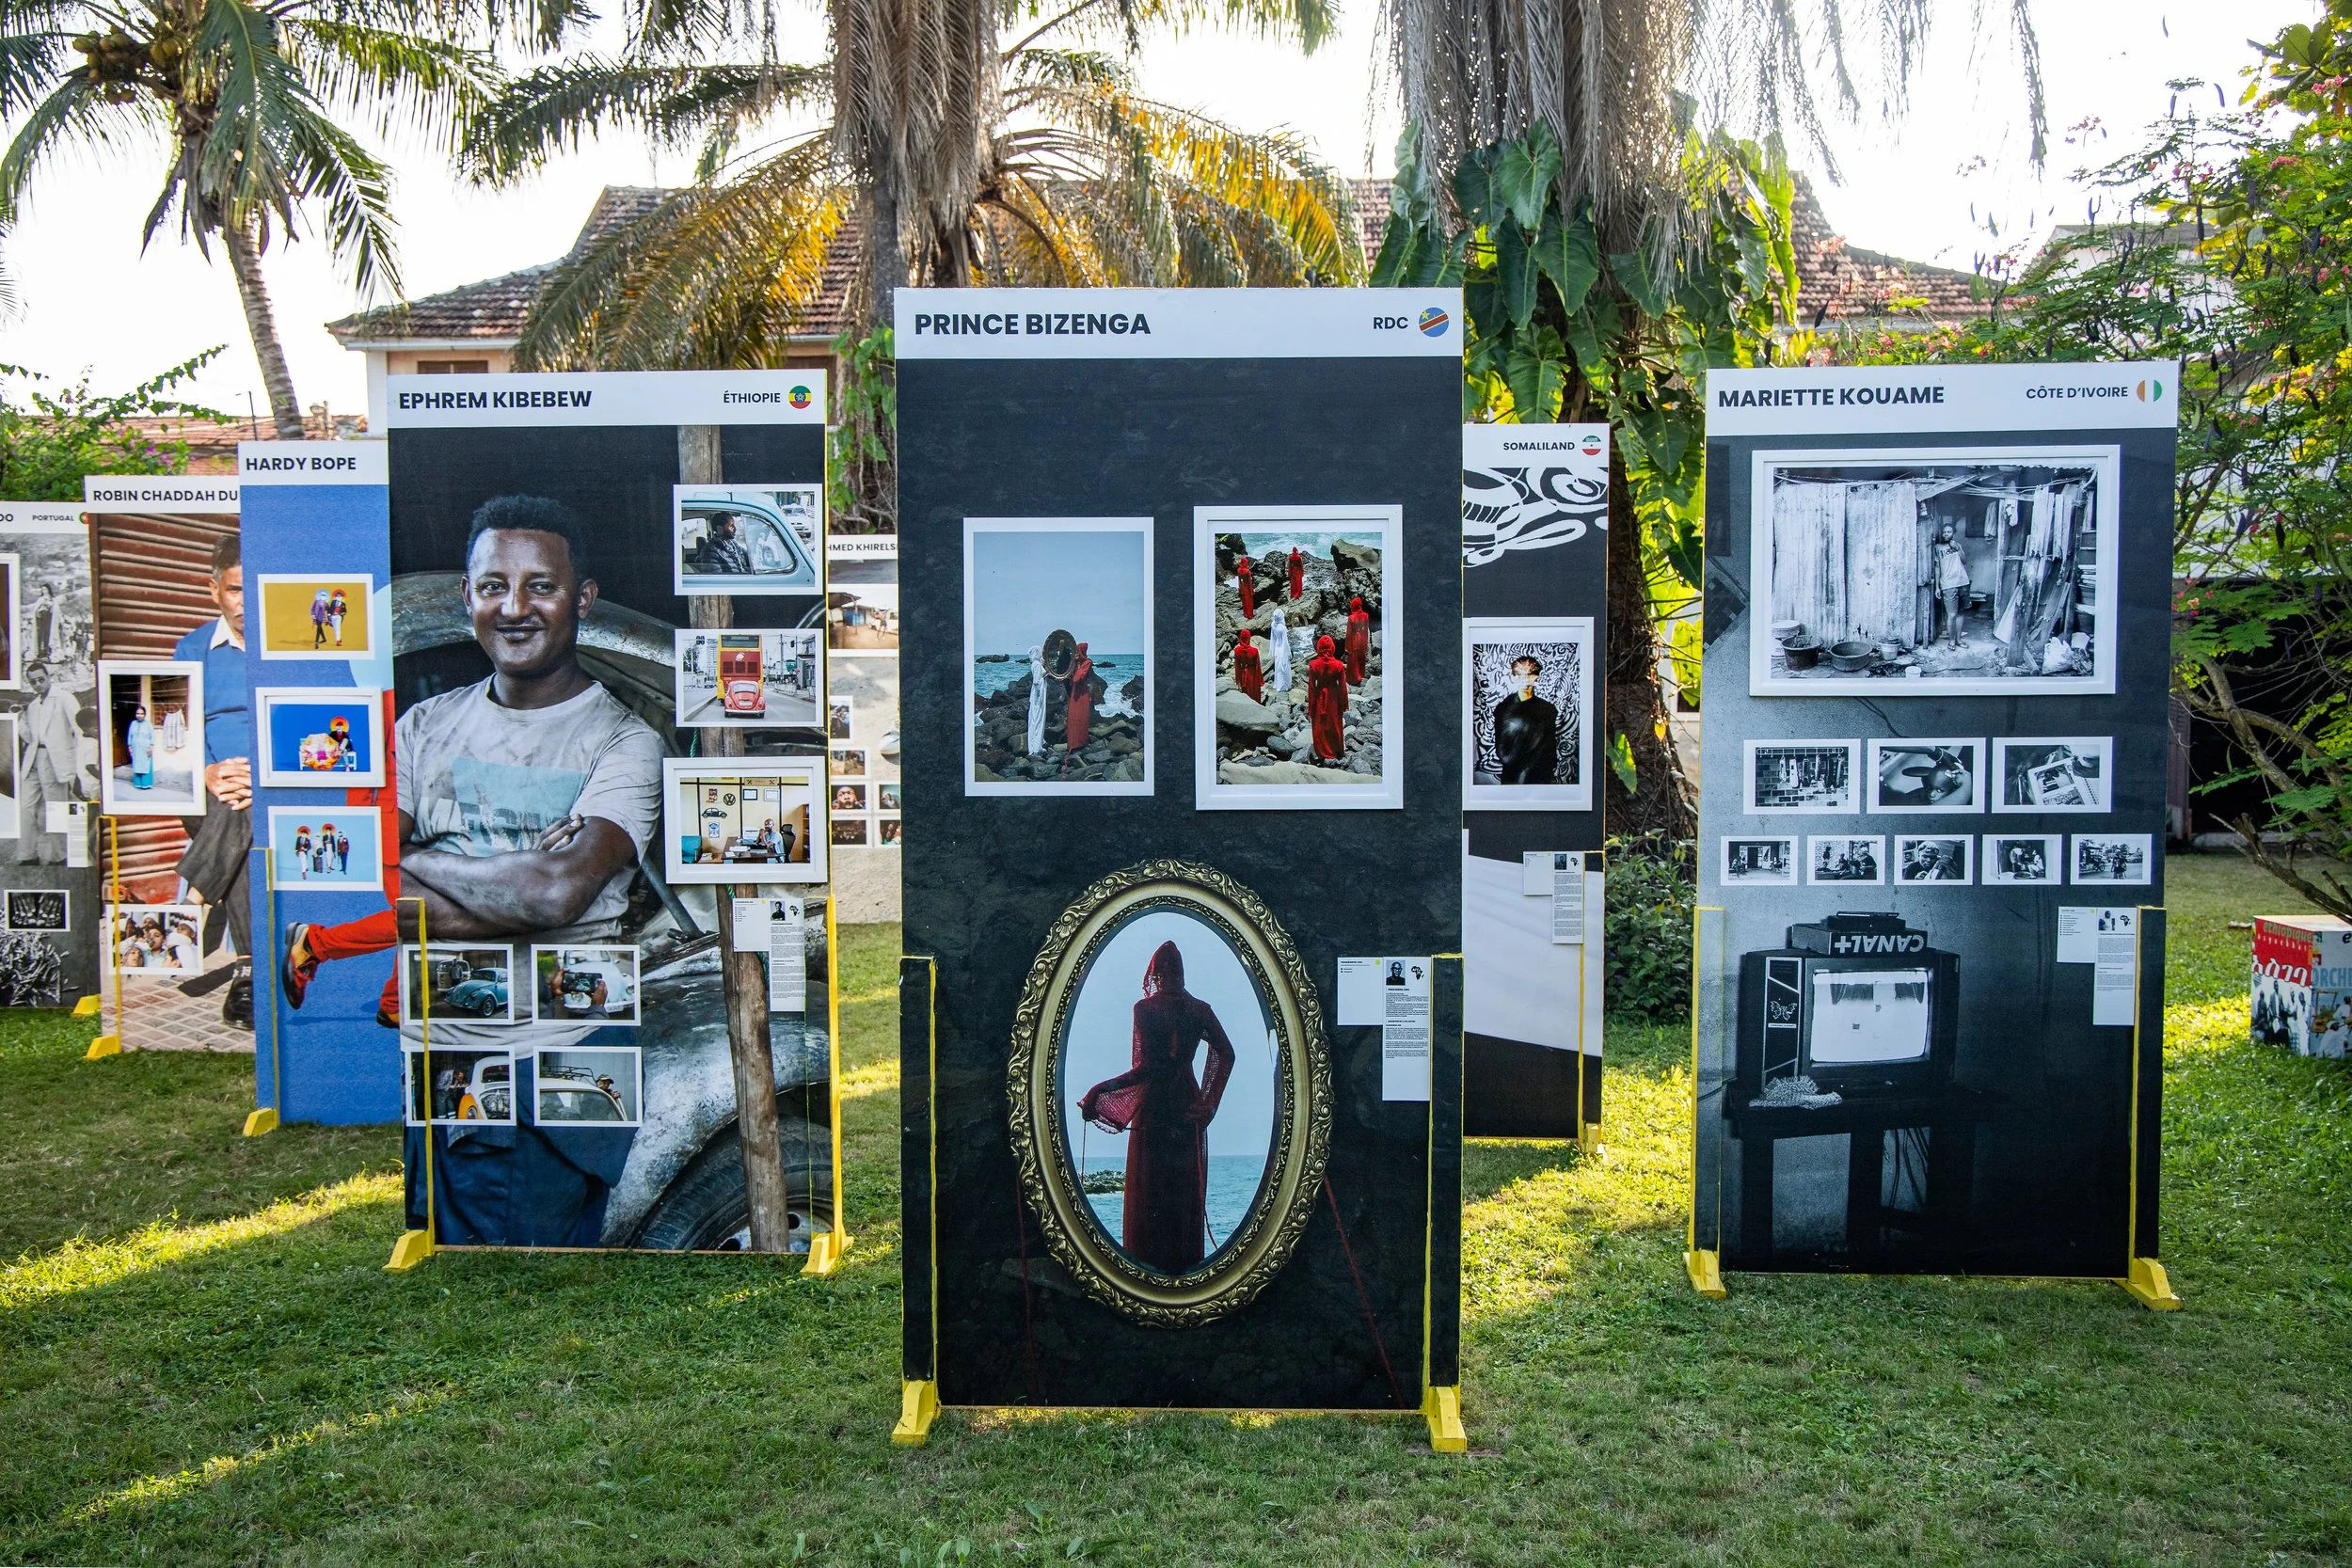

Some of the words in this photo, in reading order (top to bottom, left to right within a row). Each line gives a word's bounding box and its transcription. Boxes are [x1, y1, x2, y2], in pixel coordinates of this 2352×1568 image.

[914, 313, 1019, 335] PRINCE
[1025, 313, 1152, 335] BIZENGA
[1373, 316, 1408, 330] RDC
[399, 391, 487, 409] EPHREM
[492, 390, 593, 408] KIBEBEW
[723, 389, 781, 404] ÉTHIOPIE
[1718, 388, 1835, 407] MARIETTE
[1839, 386, 1945, 405] KOUAME
[2026, 385, 2064, 399] CÔTE
[1502, 441, 1576, 451] SOMALILAND
[246, 457, 308, 471] HARDY
[310, 456, 357, 470] BOPE
[93, 490, 138, 501] ROBIN
[141, 490, 215, 501] CHADDAH
[218, 490, 238, 501] DU
[855, 543, 897, 551] KHIRELS
[1834, 933, 1926, 954] CANAL+
